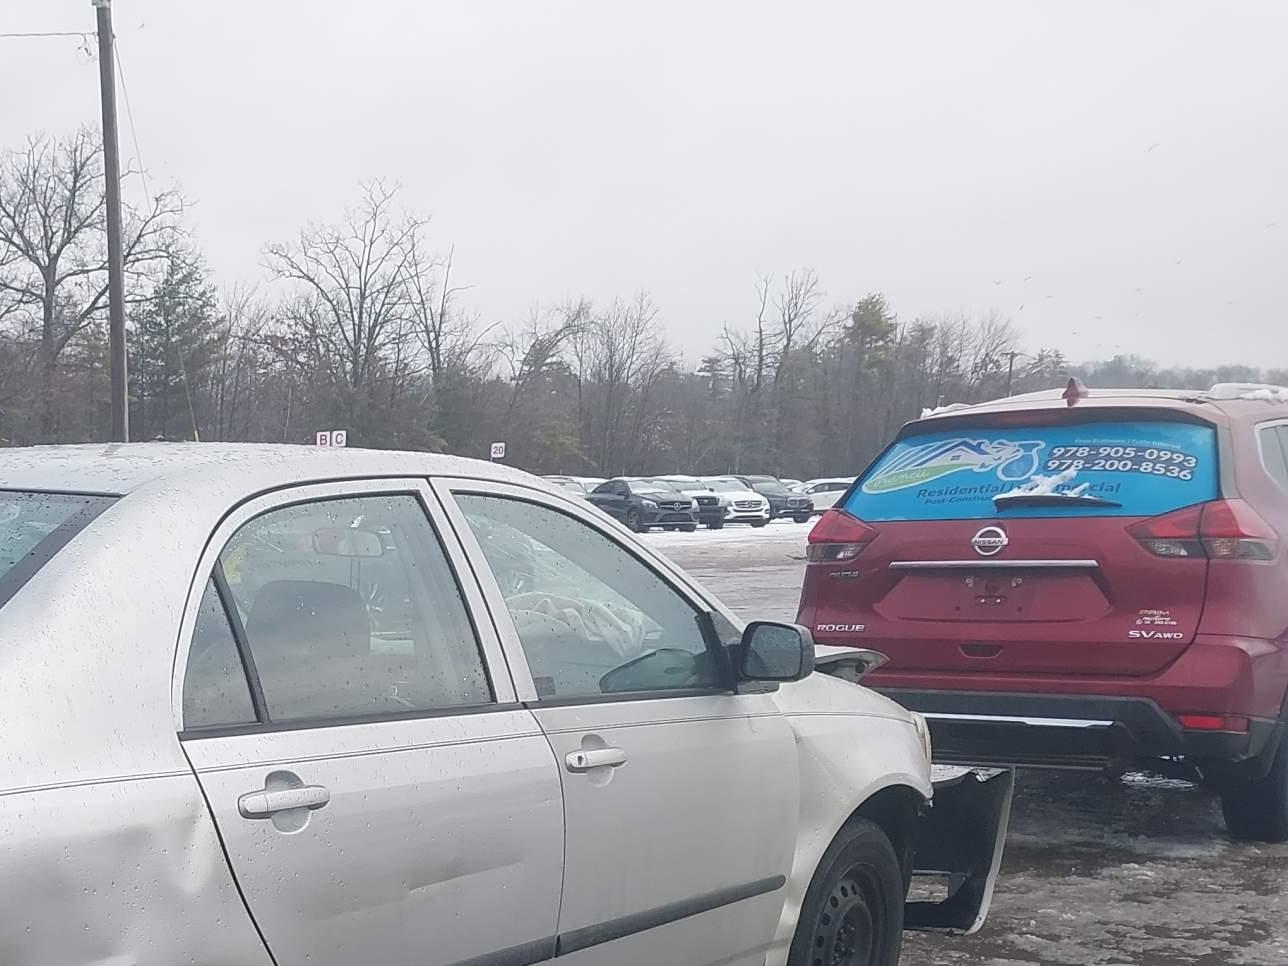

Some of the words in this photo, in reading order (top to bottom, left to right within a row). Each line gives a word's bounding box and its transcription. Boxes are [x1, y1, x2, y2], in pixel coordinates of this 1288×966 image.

[319, 434, 328, 446] B
[335, 433, 345, 445] C
[492, 446, 504, 455] 20
[1052, 446, 1197, 468] 978-905-0993
[1047, 459, 1193, 481] 978-200-8536
[917, 483, 1007, 498] Residential
[973, 538, 1004, 546] NISSAN
[817, 624, 865, 632] ROGUE
